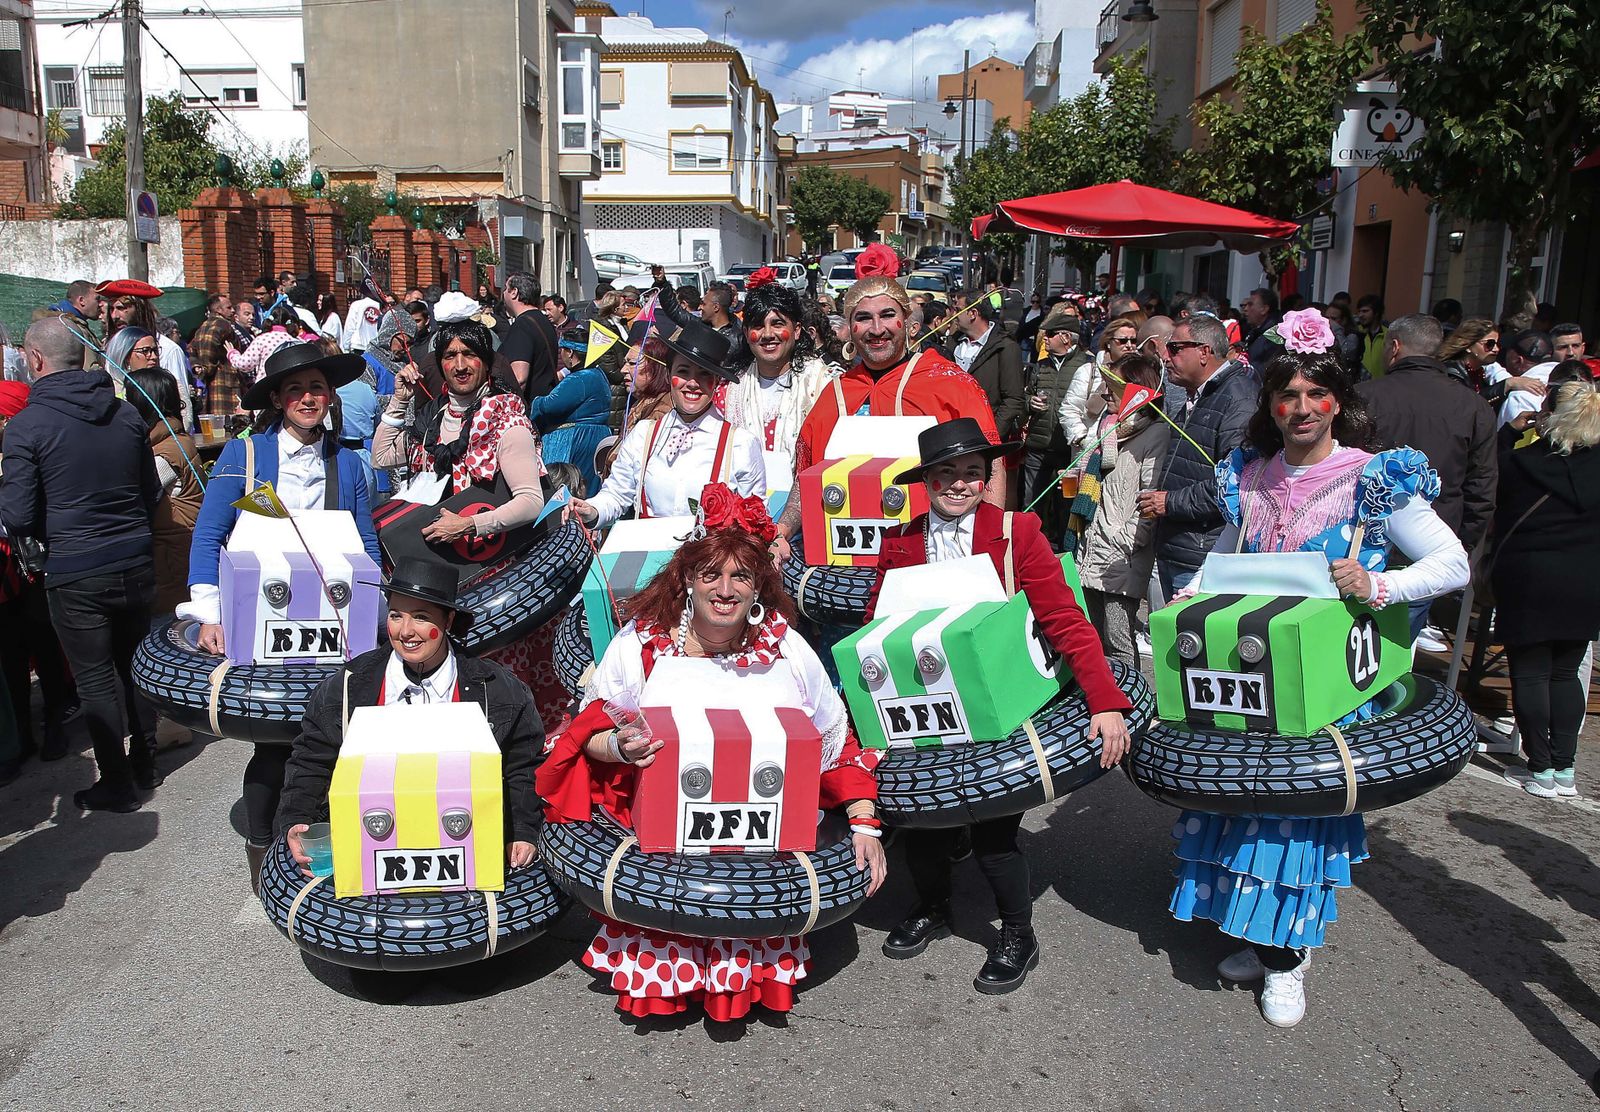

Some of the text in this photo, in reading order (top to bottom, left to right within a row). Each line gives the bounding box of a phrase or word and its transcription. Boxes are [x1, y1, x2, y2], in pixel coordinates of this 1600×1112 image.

[1338, 149, 1373, 161] CINE
[270, 627, 341, 653] KFN
[1350, 619, 1379, 684] 21
[1191, 677, 1262, 711] KFN
[884, 701, 959, 733] KFN
[687, 808, 772, 841] KFN
[382, 854, 460, 882] KFN
